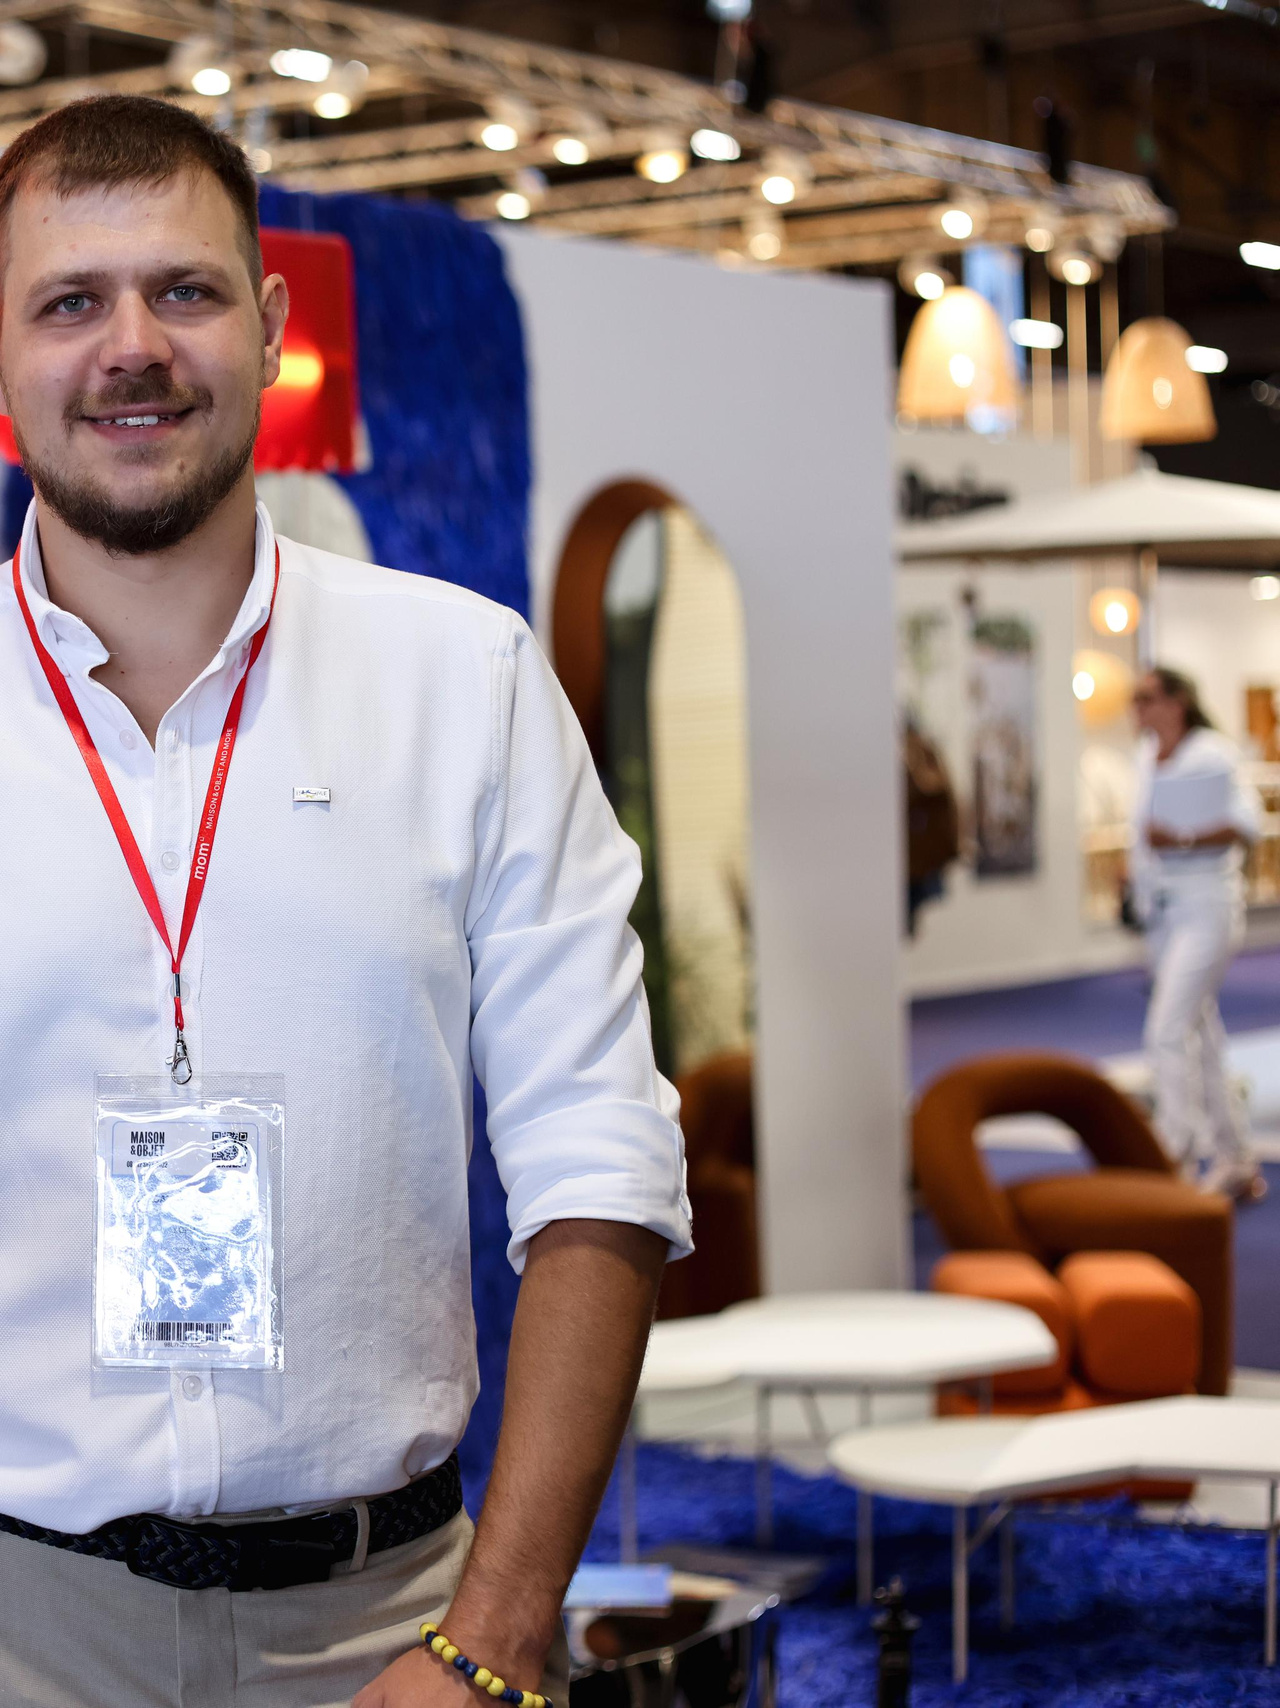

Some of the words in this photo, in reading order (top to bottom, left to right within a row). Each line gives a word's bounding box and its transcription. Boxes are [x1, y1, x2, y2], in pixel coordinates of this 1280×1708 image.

[223, 727, 234, 750] MORE
[219, 750, 228, 767] AND
[214, 767, 224, 791] OBJET
[206, 797, 218, 829] MAISON
[194, 842, 210, 880] mom
[130, 1131, 165, 1144] MAISON
[130, 1144, 165, 1157] &OBJET
